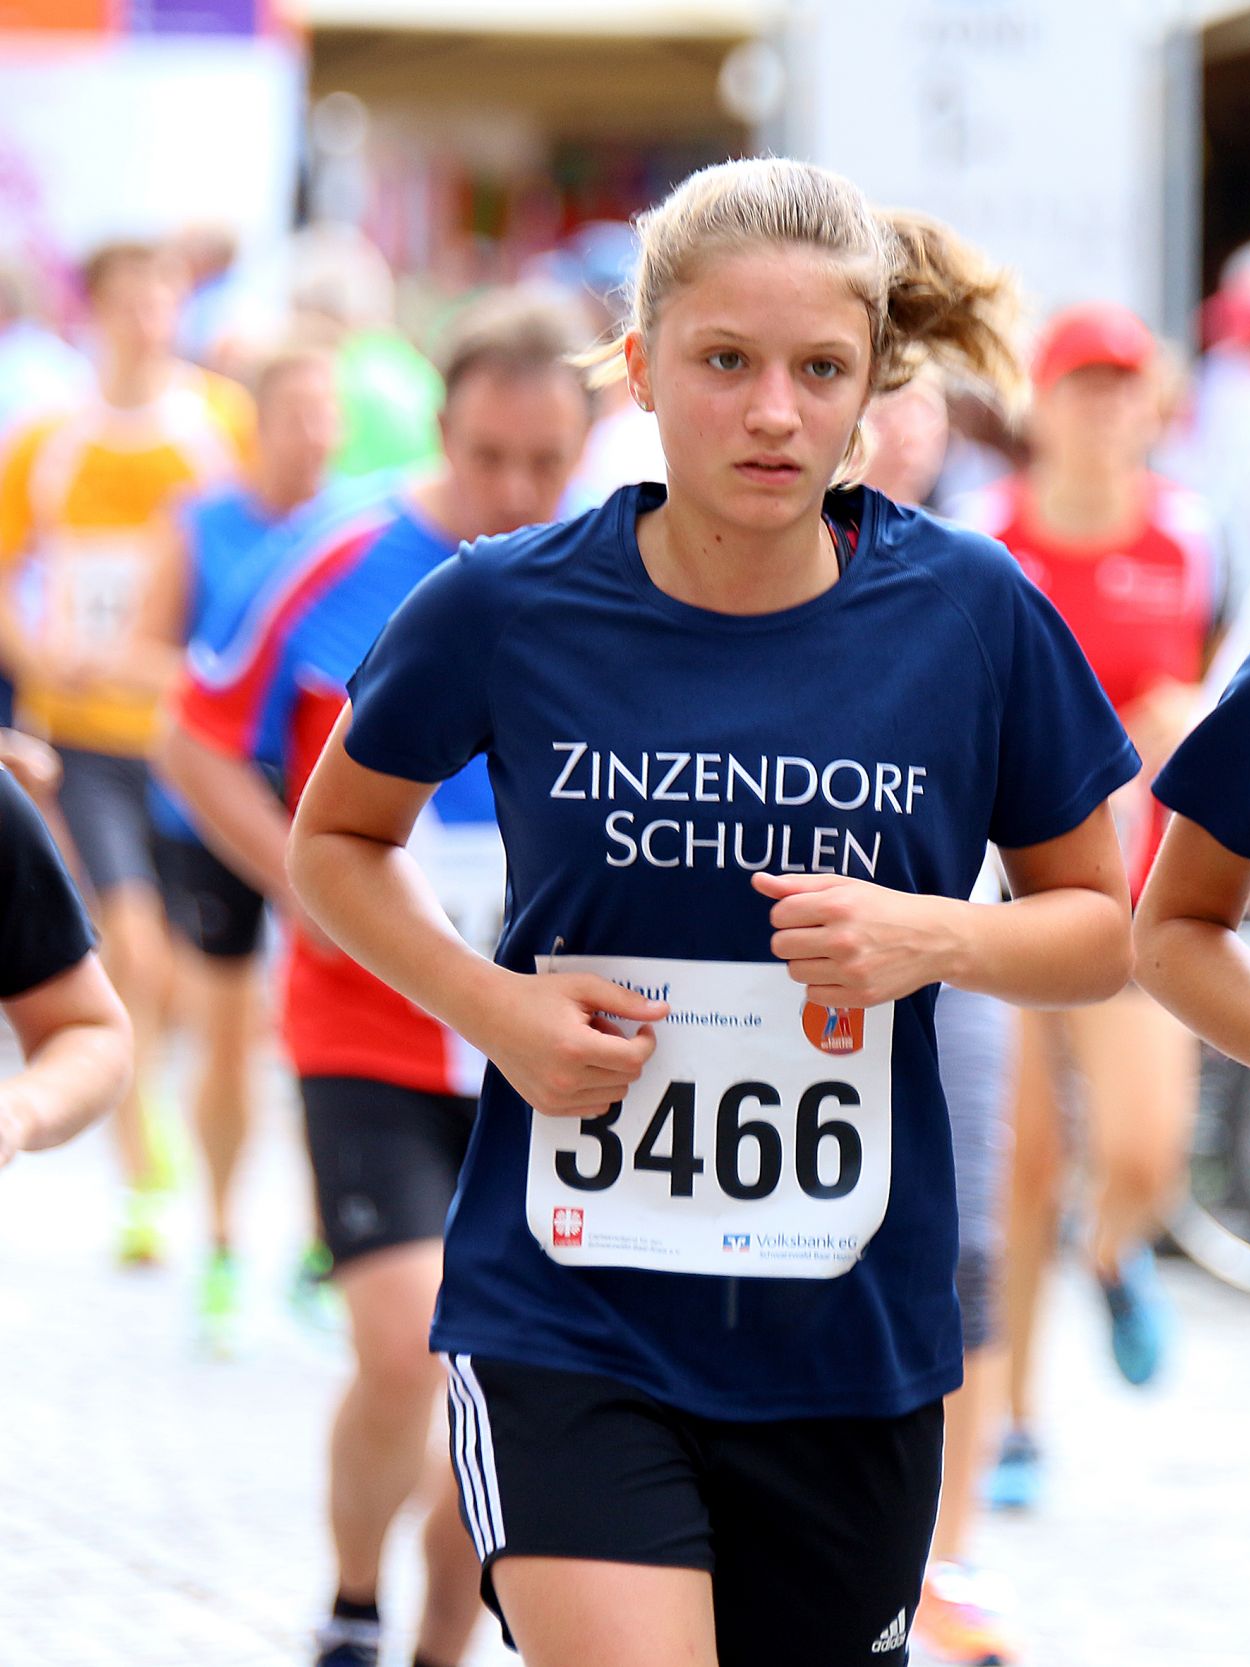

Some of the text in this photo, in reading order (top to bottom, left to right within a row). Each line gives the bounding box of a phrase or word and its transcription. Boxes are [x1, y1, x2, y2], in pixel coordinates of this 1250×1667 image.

[550, 741, 927, 814] ZINZENDORF
[605, 810, 881, 878] SCHULEN
[554, 1081, 863, 1200] 3466
[756, 1231, 858, 1250] Volksbank eG
